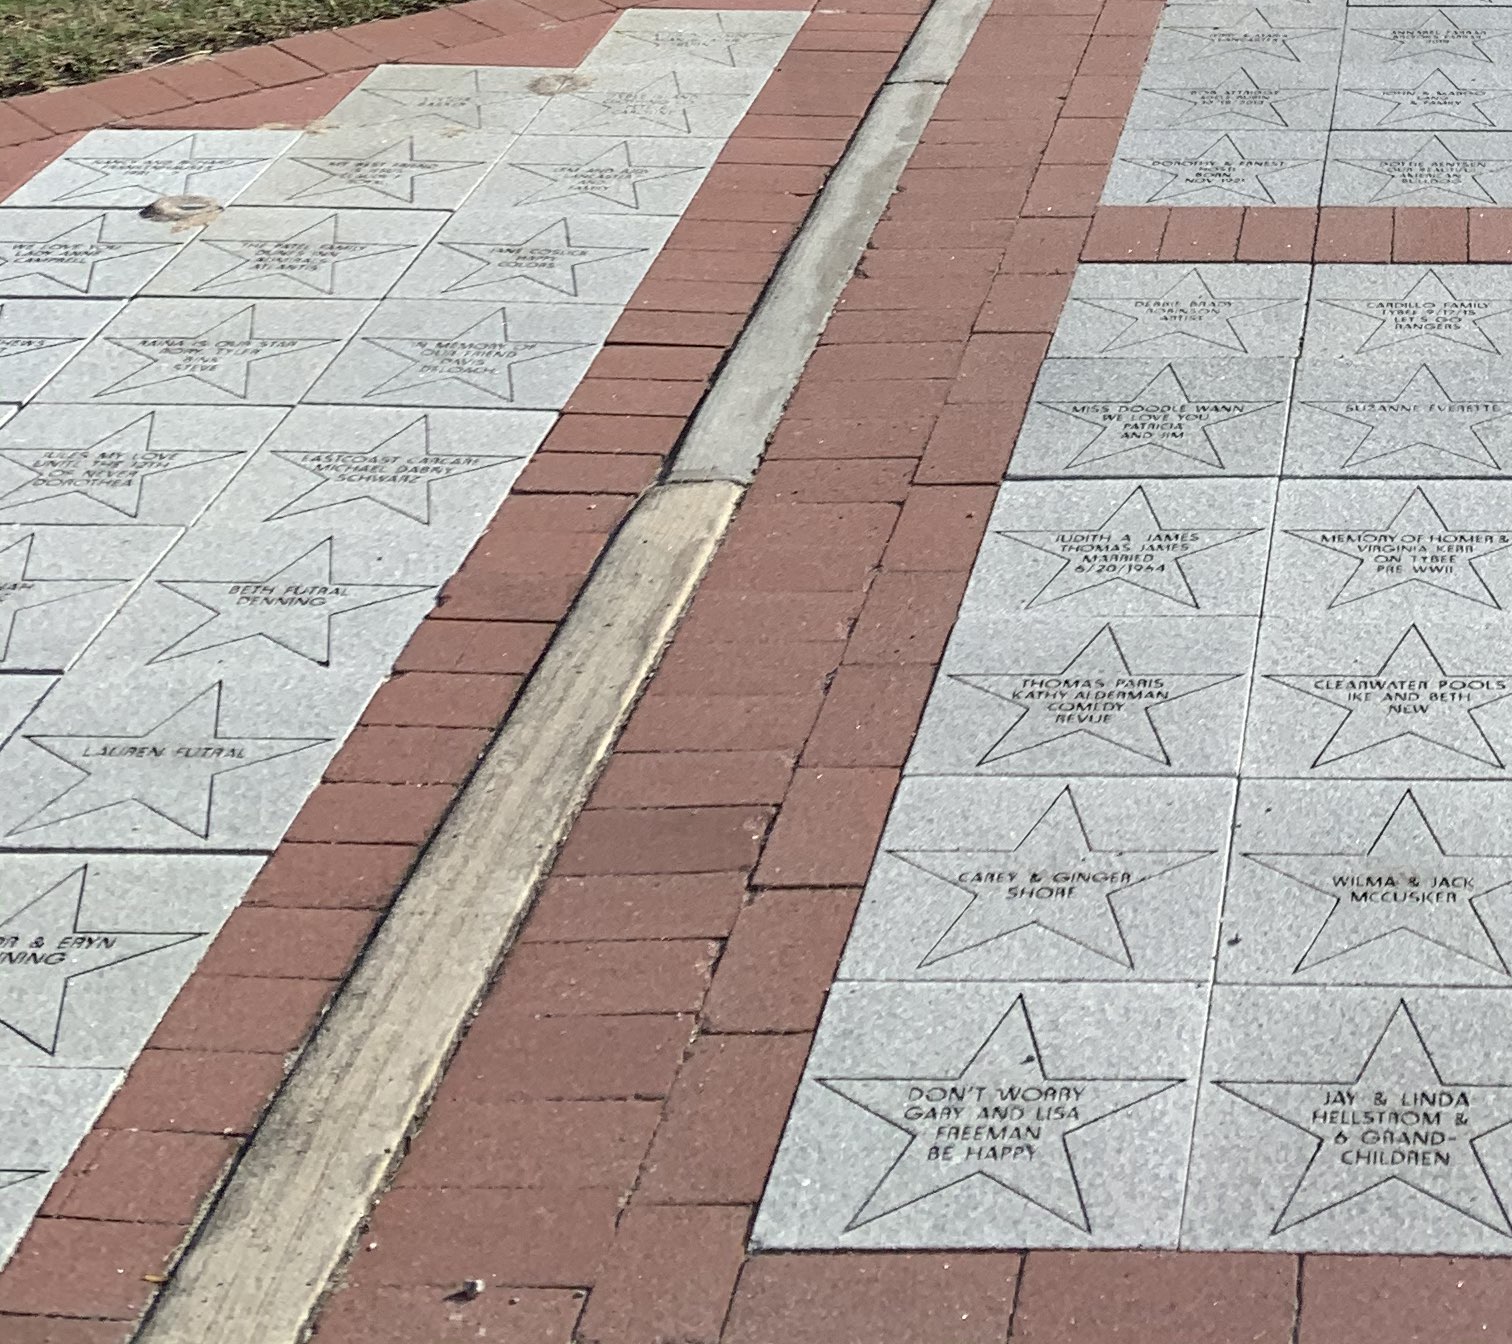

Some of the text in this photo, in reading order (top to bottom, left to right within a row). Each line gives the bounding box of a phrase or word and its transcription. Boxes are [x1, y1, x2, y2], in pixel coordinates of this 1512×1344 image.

[1072, 405, 1244, 413] MISS DOODLE WANN
[1345, 404, 1419, 412] SUZANNE
[302, 455, 399, 463] EASTCOAST
[314, 464, 385, 473] MICHAEL
[83, 470, 138, 478] NEVER
[335, 474, 422, 483] SCHWARZ
[32, 479, 133, 487] DOROTHEA
[1055, 533, 1200, 543] JUDITH A JAMES
[1321, 534, 1510, 544] MEMORY OF HOMER &
[1060, 544, 1190, 553] THOMAS JAMES
[1357, 545, 1474, 553] VIRGINIA KERR
[1082, 554, 1154, 563] MARRIED
[1374, 555, 1457, 563] ON TYBEE
[1377, 565, 1403, 573] PRE
[229, 586, 348, 596] BETH FUTRAL
[236, 596, 326, 606] DENNING
[1021, 678, 1164, 689] THOMAS PARIS
[1314, 679, 1506, 691] CLEARWATER POOLS
[1012, 690, 1169, 701] KATHY ALDERMAN
[1347, 692, 1471, 702] IKE AND BETH
[1047, 702, 1126, 712] COMEDY
[1388, 704, 1430, 714] NEW
[1054, 714, 1115, 724] REVUE
[82, 747, 245, 758] LAUREN FUTRAL
[1030, 872, 1045, 883] &
[1052, 872, 1132, 884] GINGER
[1332, 875, 1474, 888] WILMA & JACK
[1005, 886, 1076, 900] SHORE
[1350, 892, 1457, 904] MCCUSKER
[29, 937, 117, 949] & ERYN
[908, 1086, 1085, 1102] DON'T WORRY
[1324, 1091, 1469, 1107] JAY & LINDA
[904, 1106, 1079, 1121] GARY AND LISA
[1312, 1111, 1468, 1126] HELLSTROM &
[936, 1126, 1041, 1141] FREEMAN
[1361, 1130, 1456, 1146] GRAND-
[927, 1145, 1037, 1161] BE HAPPY
[1341, 1150, 1450, 1166] CHILDREN
